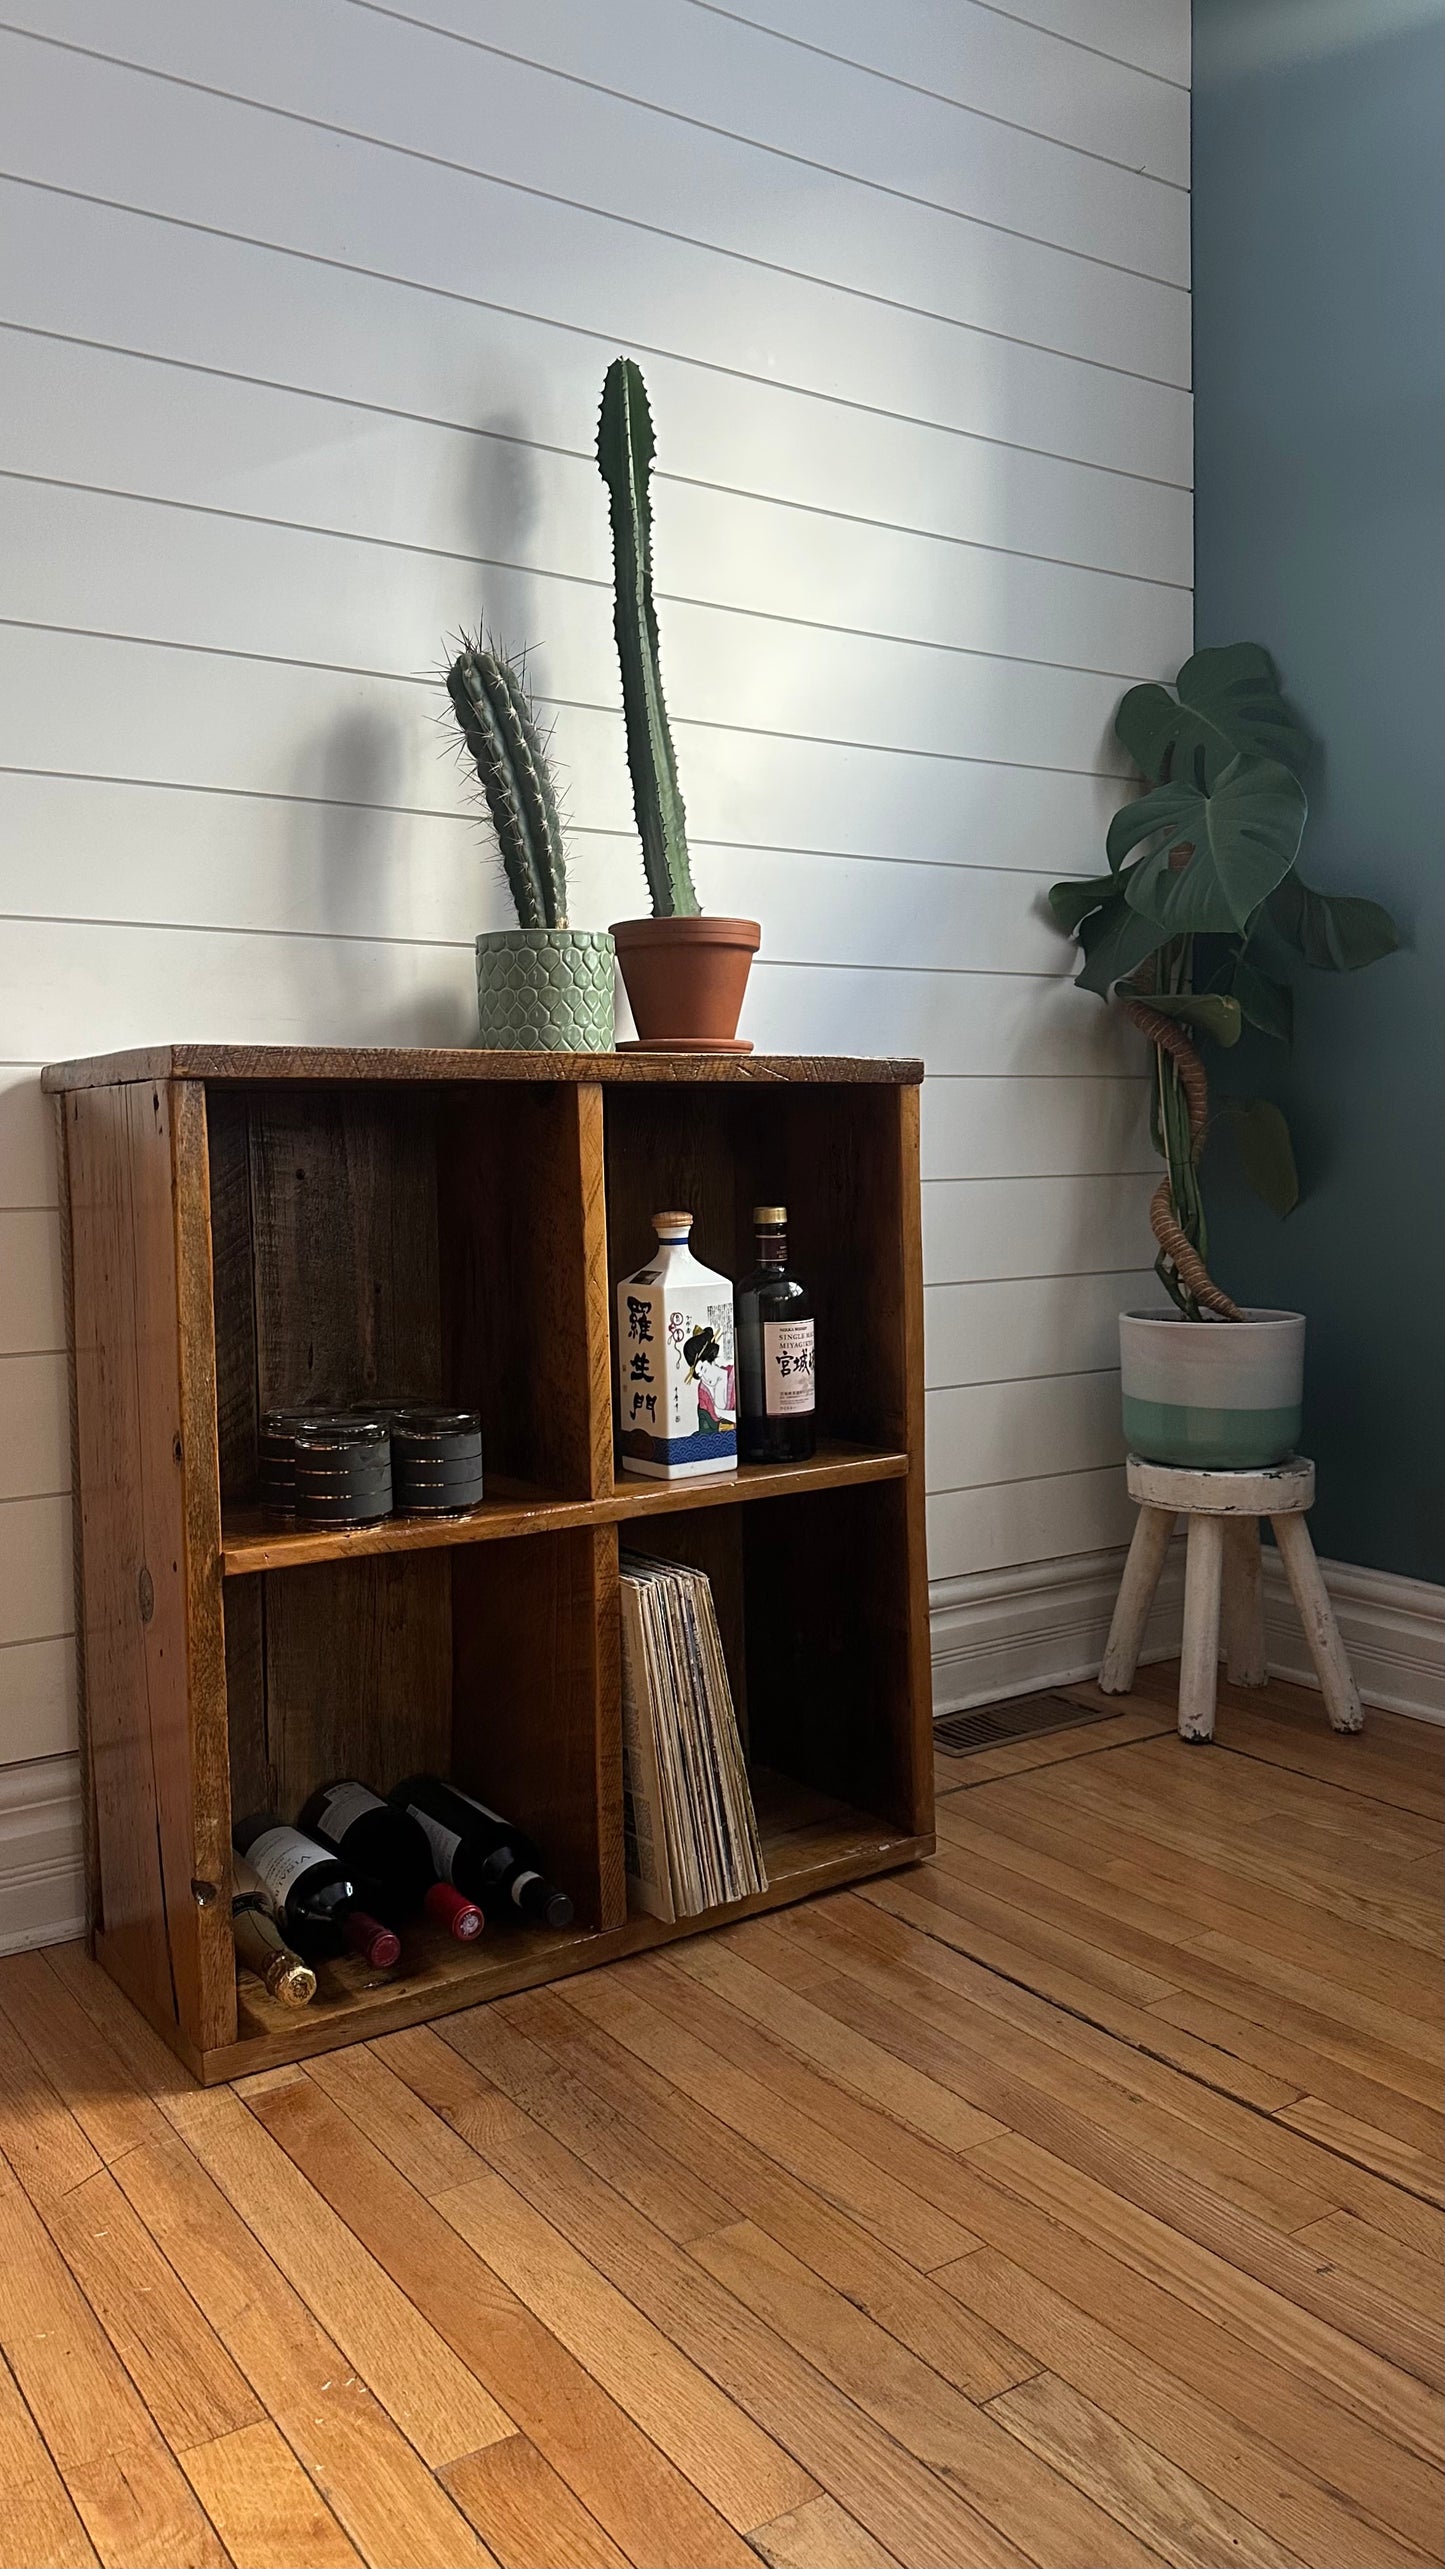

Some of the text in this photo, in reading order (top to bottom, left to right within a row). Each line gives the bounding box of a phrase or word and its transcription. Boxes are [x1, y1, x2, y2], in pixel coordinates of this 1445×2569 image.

[626, 1296, 657, 1423] 羅生門
[778, 1333, 805, 1341] SINGLE
